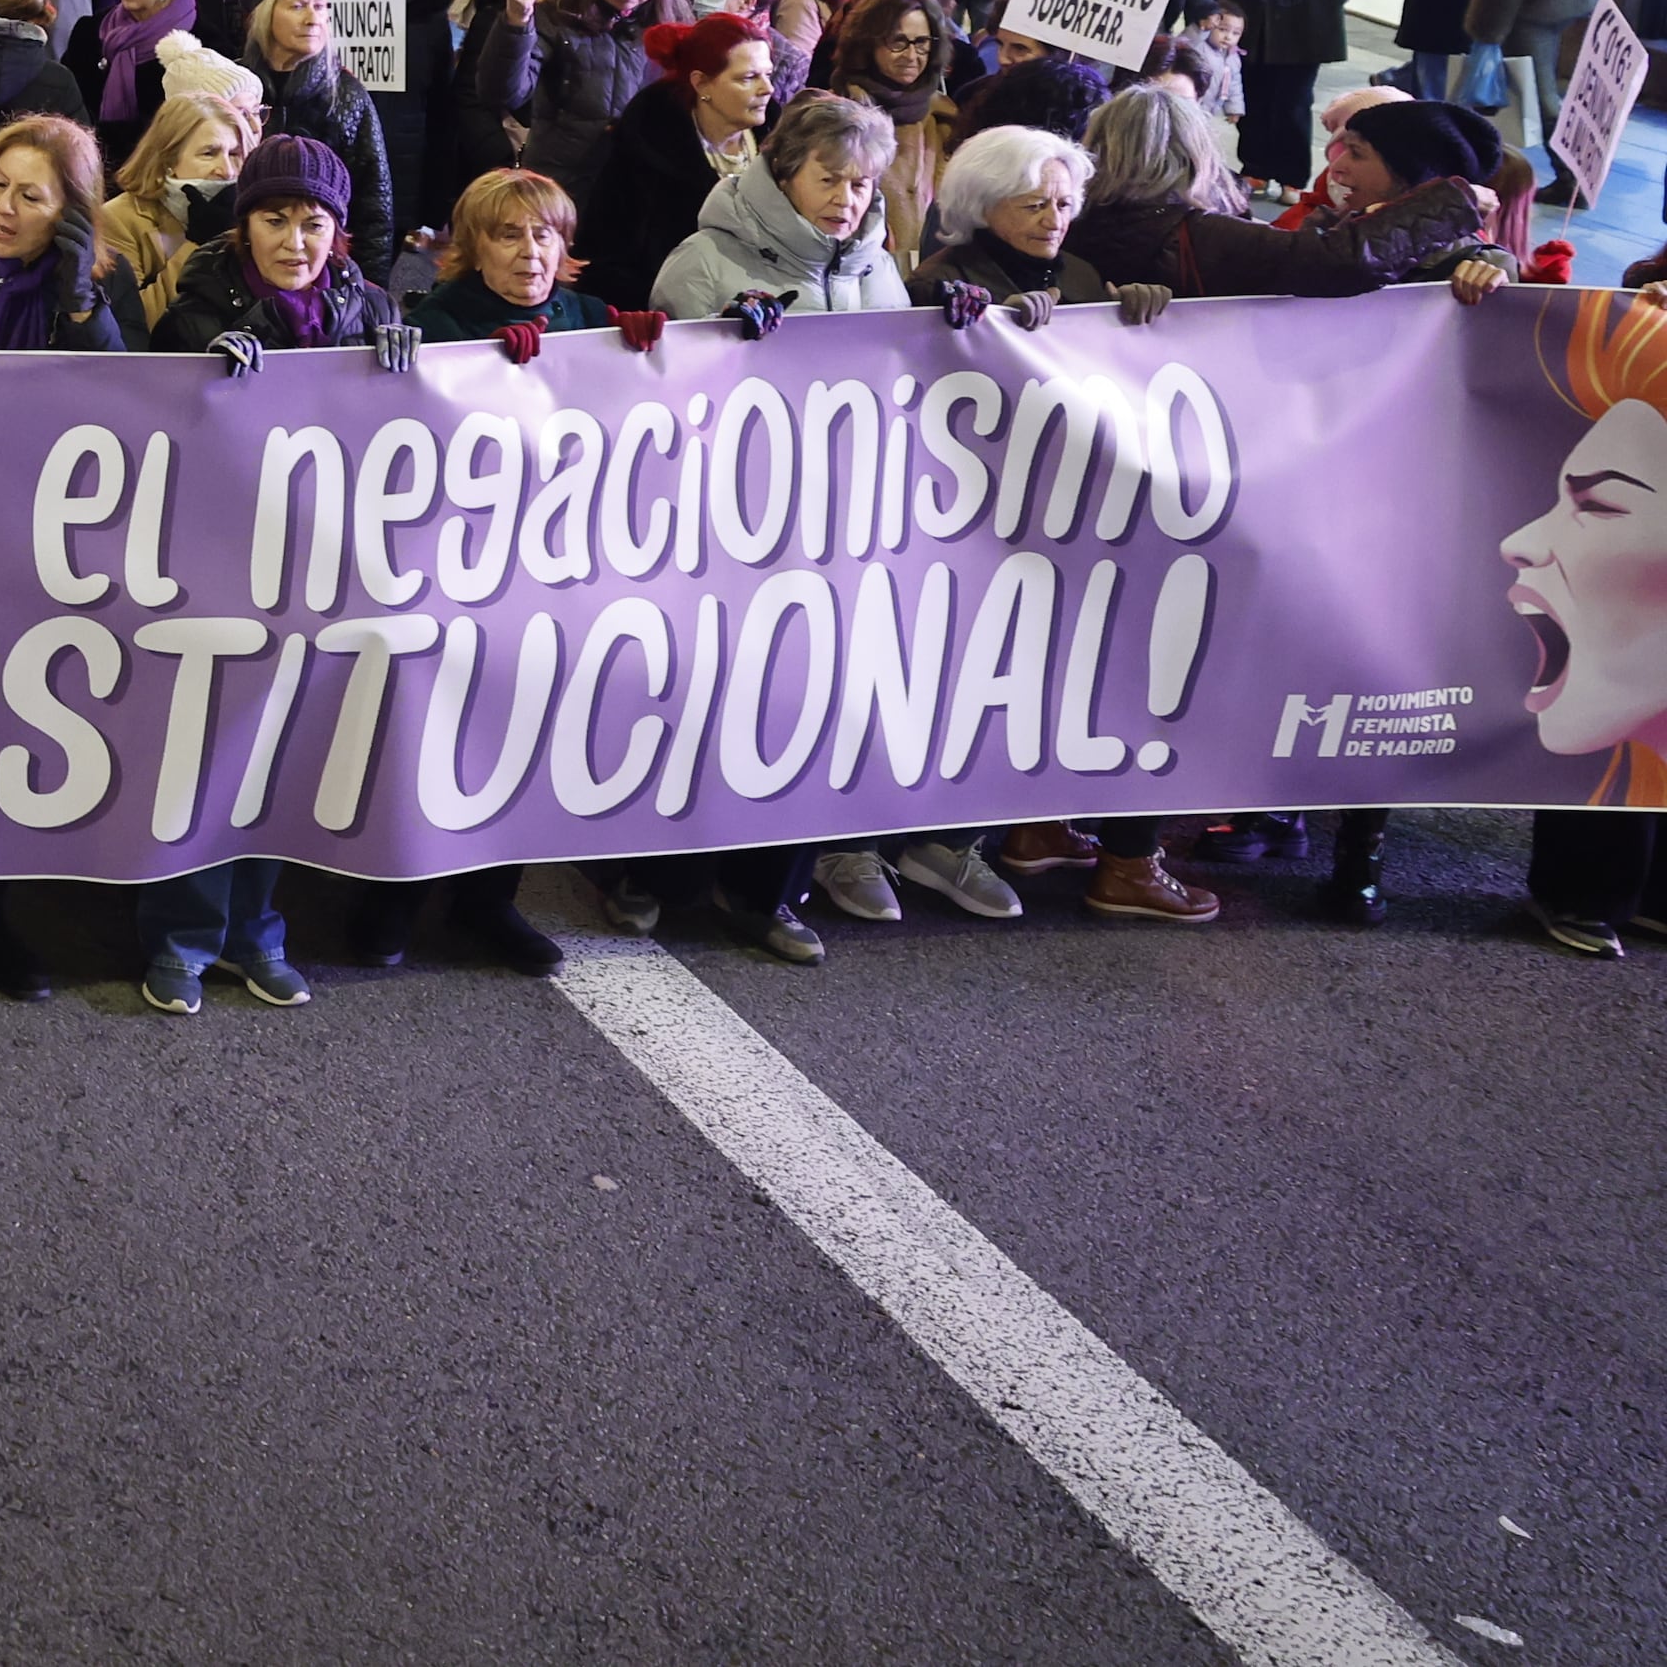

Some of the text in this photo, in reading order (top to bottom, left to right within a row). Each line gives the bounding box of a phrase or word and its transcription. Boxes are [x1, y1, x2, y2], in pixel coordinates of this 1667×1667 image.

[33, 424, 178, 606] el
[250, 361, 1233, 612] negacionismo
[1356, 686, 1474, 712] MOVIMIENTO
[1350, 712, 1457, 734] FEMINISTA
[1344, 737, 1457, 757] DE MADRID
